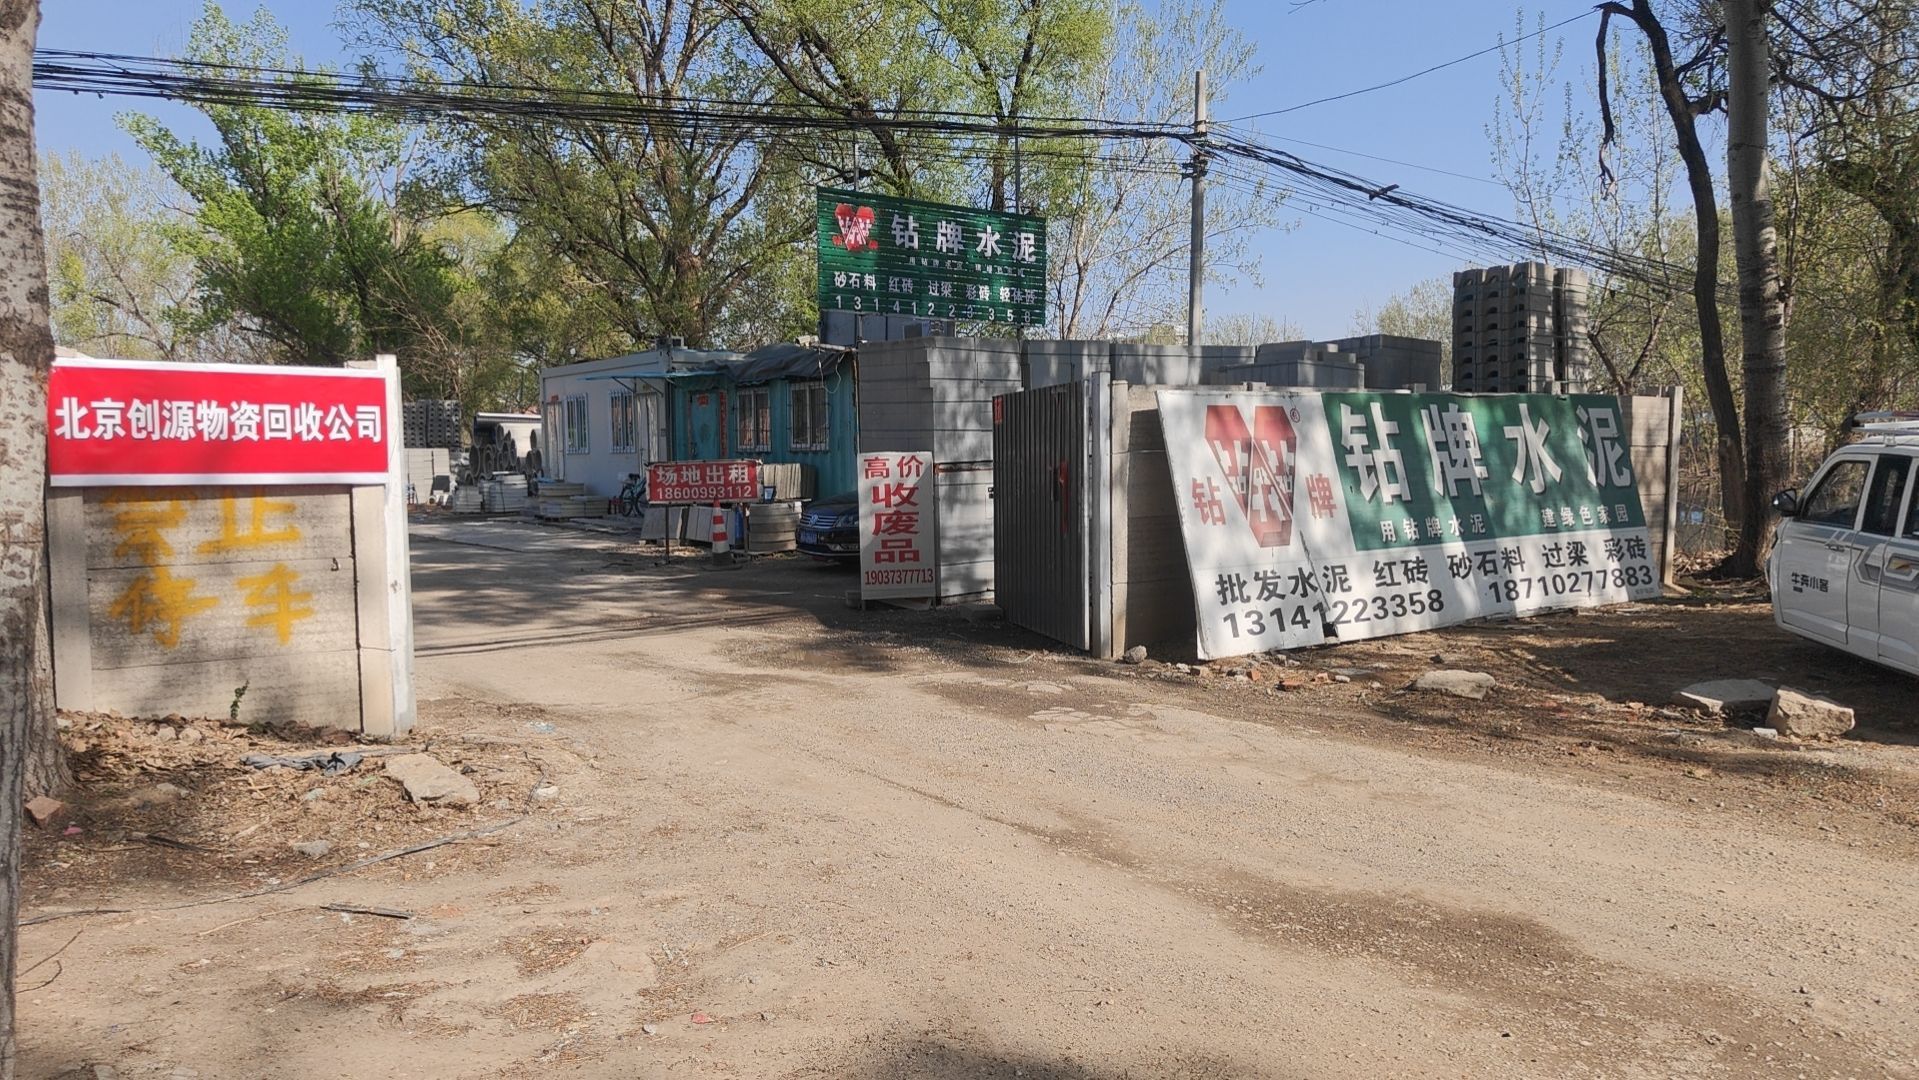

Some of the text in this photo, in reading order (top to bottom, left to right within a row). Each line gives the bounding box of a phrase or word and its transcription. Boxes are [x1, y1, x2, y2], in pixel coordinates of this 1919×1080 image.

[891, 214, 1036, 263] 钻牌水泥
[834, 271, 877, 290] 砂石料
[888, 276, 914, 294] 红砖
[928, 280, 952, 297] 过梁
[965, 285, 990, 301] 彩砖
[834, 295, 1031, 323] 13141223358
[54, 397, 382, 443] 北京创源物资回收公司
[863, 455, 924, 480] 高价
[1340, 401, 1632, 505] 钻牌水泥
[656, 464, 751, 486] 场地出租
[656, 485, 752, 500] 18600993112
[872, 482, 921, 565] 收废品
[1379, 503, 1630, 544] 用钻牌水泥 建绿色家园
[864, 568, 934, 585] 19037377713
[1217, 536, 1647, 606] 批发水泥 红砖 砂石料 过梁 彩砖
[107, 562, 316, 650] 停车
[1222, 567, 1654, 639] 13141223358 18710277883
